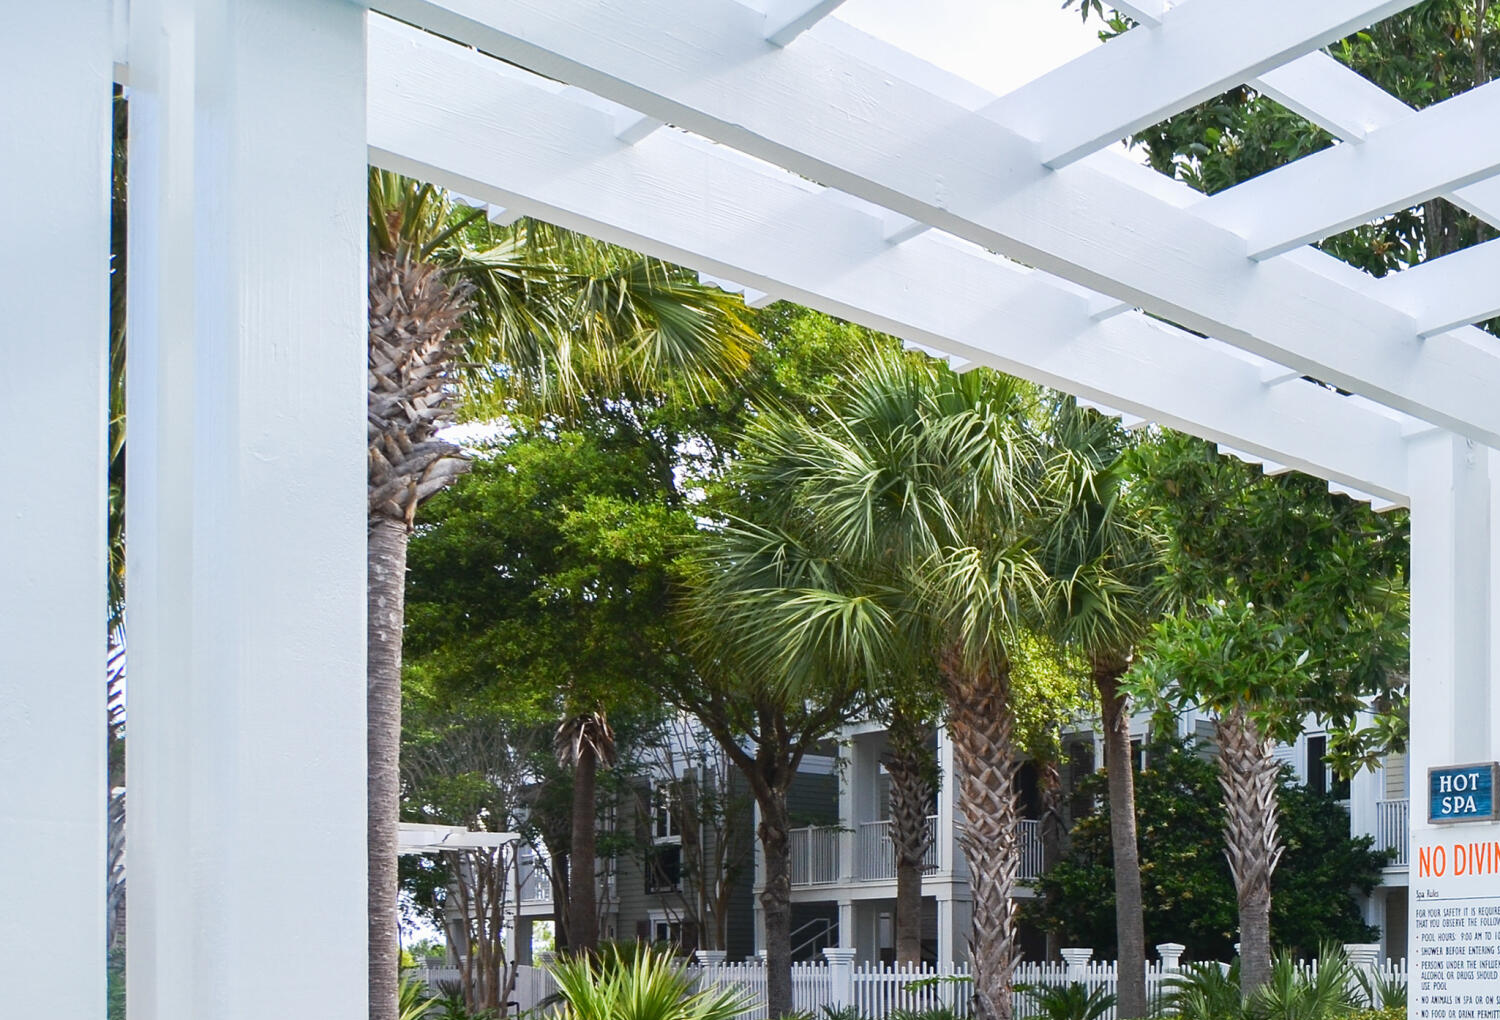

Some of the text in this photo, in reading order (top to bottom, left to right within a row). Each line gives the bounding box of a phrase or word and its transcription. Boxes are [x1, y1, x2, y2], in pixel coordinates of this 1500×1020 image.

[1440, 773, 1479, 793] HOT
[1442, 796, 1477, 814] SPA
[1419, 845, 1446, 878] NO
[1416, 889, 1424, 900] Spa
[1416, 909, 1427, 918] FOR
[1428, 909, 1441, 918] YOUR
[1443, 908, 1461, 917] SAFETY
[1464, 907, 1468, 916] IT
[1471, 907, 1476, 916] IS
[1416, 919, 1428, 928] THAT
[1430, 919, 1440, 928] YOU
[1442, 918, 1465, 927] OBSERVE
[1468, 918, 1477, 927] THE
[1421, 933, 1435, 942] POOL
[1474, 932, 1482, 941] AM
[1485, 932, 1491, 940] TO
[1421, 946, 1443, 955] SHOWER
[1446, 946, 1465, 955] BEFORE
[1468, 946, 1495, 955] ENTERING
[1421, 961, 1444, 969] PERSONS
[1446, 960, 1464, 969] UNDER
[1467, 960, 1477, 969] THE
[1421, 971, 1444, 980] ALCOHOL
[1446, 971, 1454, 980] OR
[1457, 971, 1474, 980] DRUGS
[1477, 971, 1498, 980] SHOULD
[1421, 982, 1447, 990] USE POOL
[1421, 996, 1429, 1004] NO
[1431, 996, 1452, 1004] ANIMALS
[1455, 996, 1461, 1004] IN
[1463, 996, 1473, 1004] SPA
[1475, 996, 1483, 1004] OR
[1486, 996, 1493, 1004] ON
[1421, 1010, 1429, 1018] NO
[1432, 1010, 1446, 1018] FOOD
[1448, 1010, 1456, 1018] OR
[1459, 1010, 1474, 1018] DRINK
